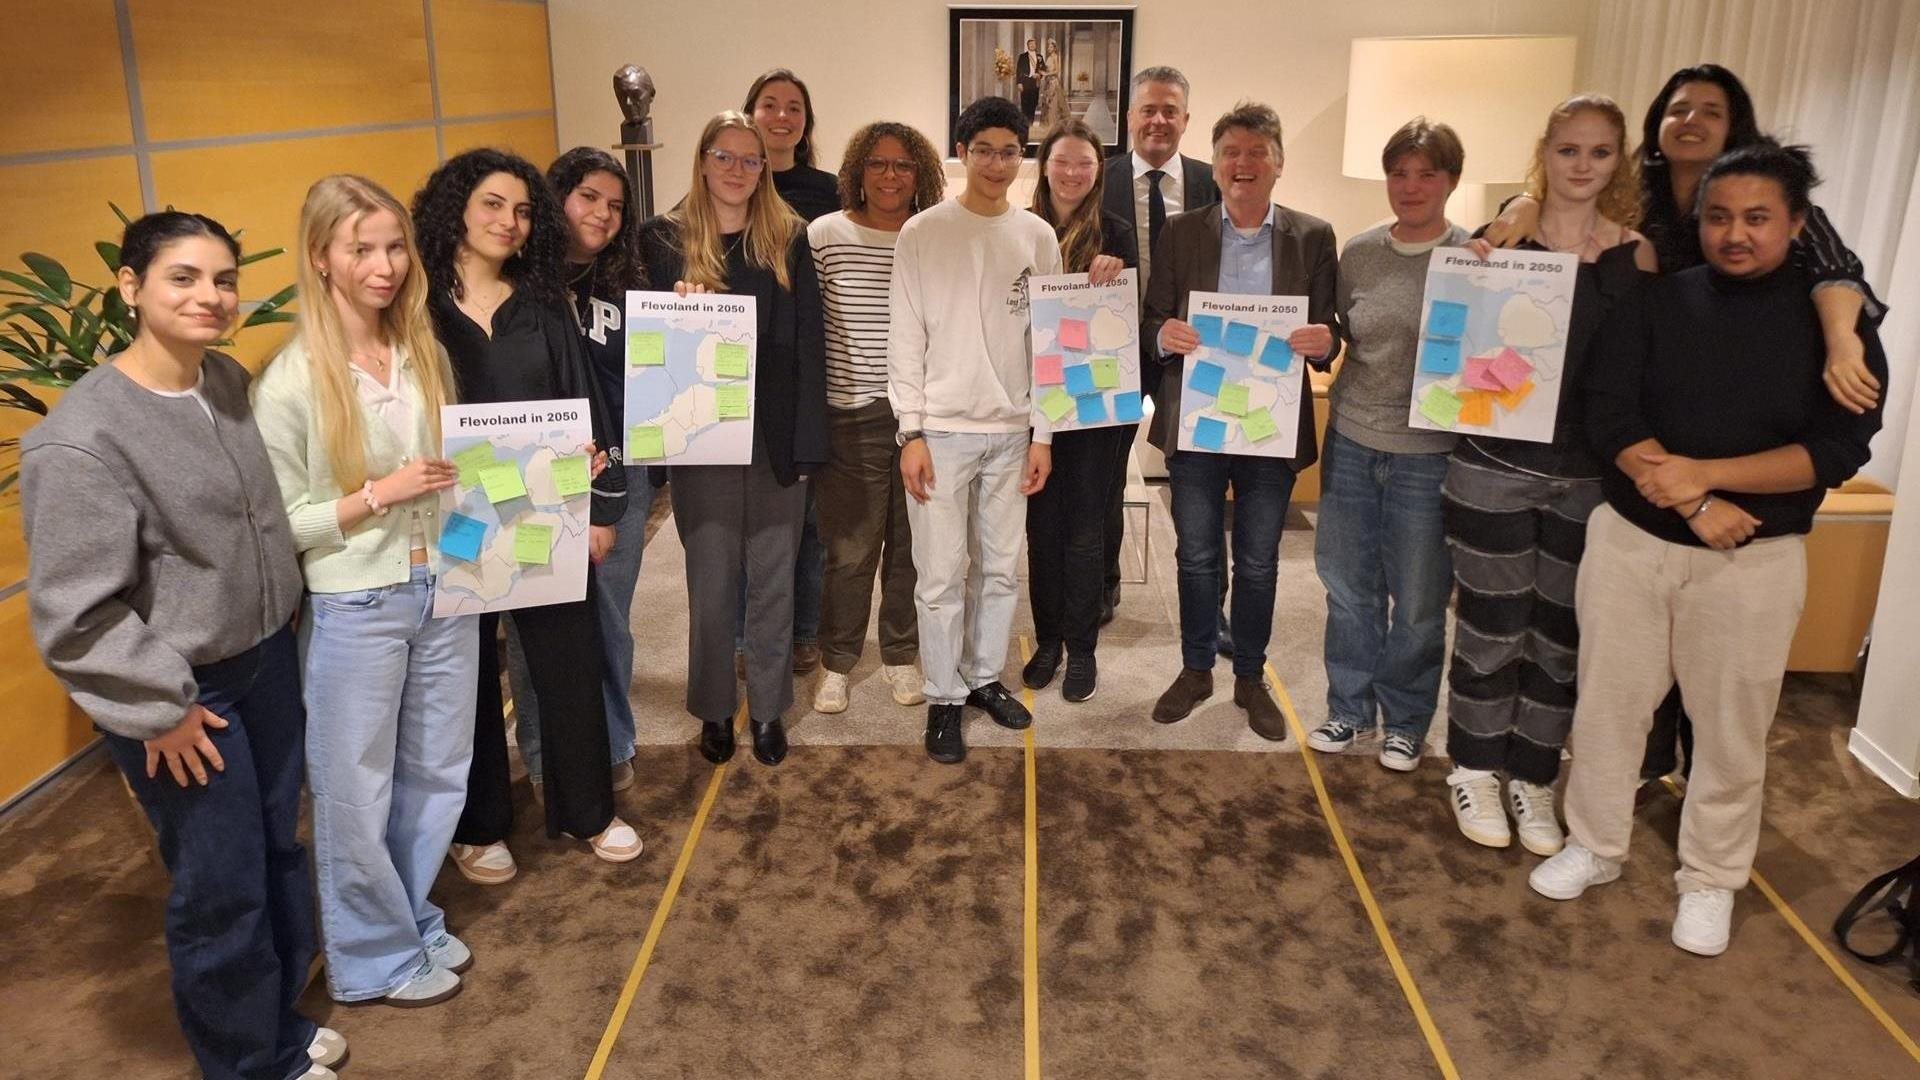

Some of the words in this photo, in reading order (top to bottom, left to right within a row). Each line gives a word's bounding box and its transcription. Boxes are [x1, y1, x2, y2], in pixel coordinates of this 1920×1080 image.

[1445, 257, 1508, 269] Flevoland
[1512, 261, 1525, 270] in
[1529, 262, 1563, 273] 2050
[1041, 283, 1091, 292] Flevoland
[1105, 278, 1128, 288] 2050
[641, 301, 699, 312] Flevoland
[703, 303, 714, 313] in
[717, 304, 745, 313] 2050
[1202, 301, 1255, 312] Flevoland
[1258, 304, 1268, 313] in
[1271, 305, 1298, 314] 2050
[460, 414, 526, 427] Flevoland
[531, 413, 543, 423] in
[547, 411, 578, 422] 2050
